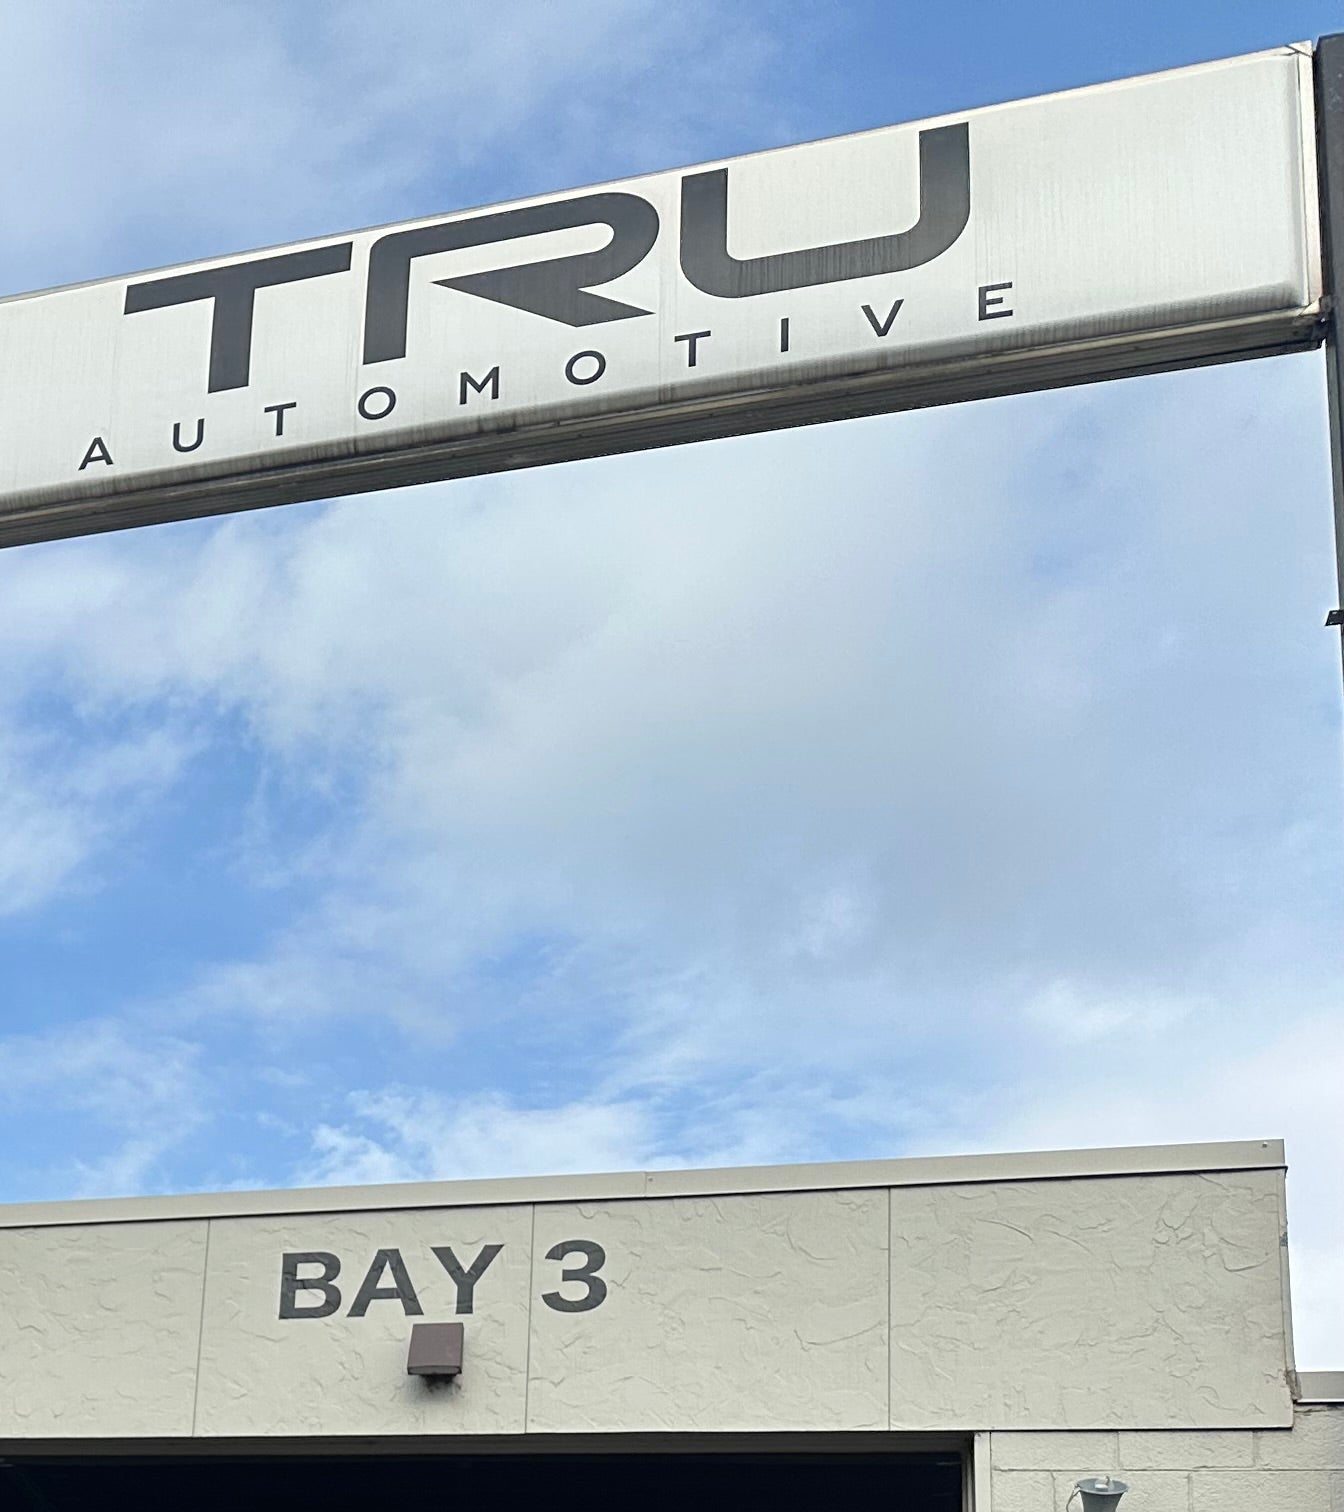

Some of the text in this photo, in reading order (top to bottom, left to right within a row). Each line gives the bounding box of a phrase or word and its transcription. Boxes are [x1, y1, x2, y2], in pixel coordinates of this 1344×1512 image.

[123, 121, 970, 393] TRU
[77, 281, 1013, 470] AUTOMOTIVE
[278, 1239, 609, 1321] BAY 3
